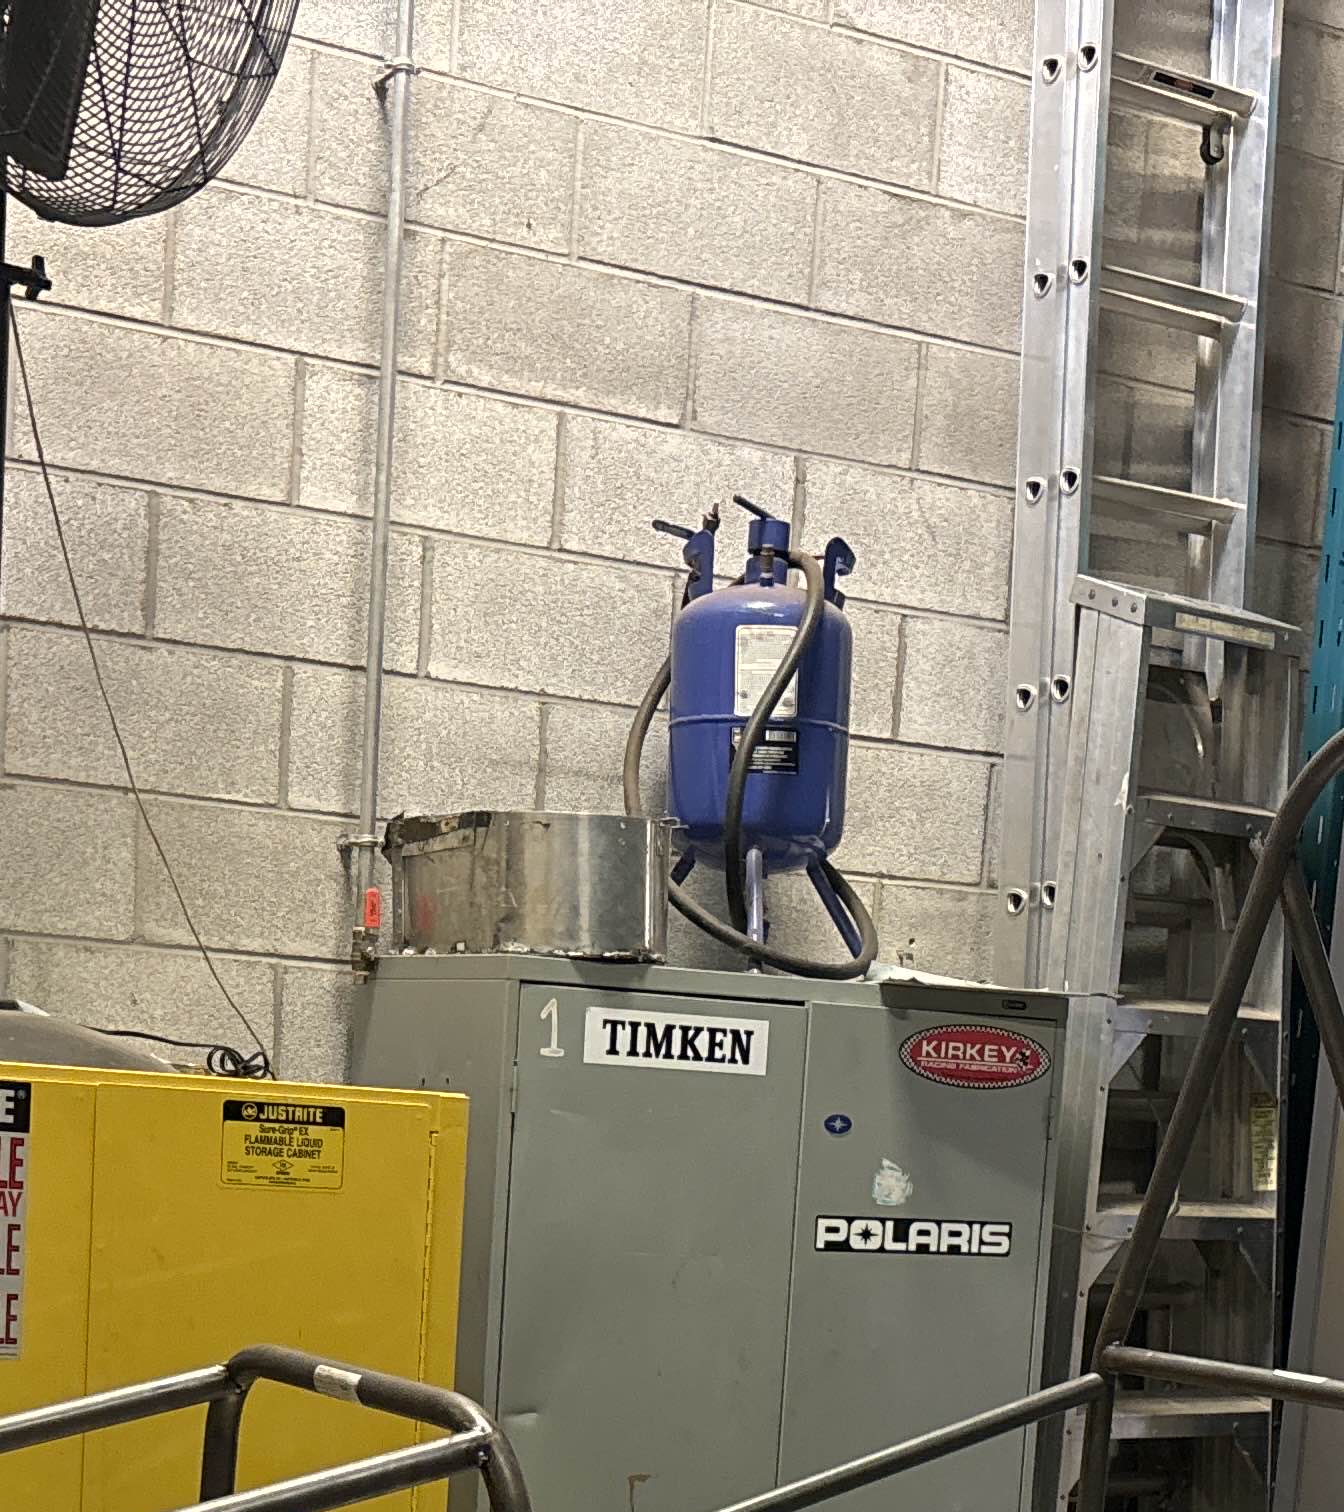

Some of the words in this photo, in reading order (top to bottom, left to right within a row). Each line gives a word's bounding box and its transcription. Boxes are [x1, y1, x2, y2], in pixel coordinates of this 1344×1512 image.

[539, 997, 565, 1058] 1
[602, 1019, 754, 1066] TIMKEN
[921, 1040, 1017, 1062] KIRKEY
[920, 1061, 958, 1070] RACING
[259, 1104, 324, 1123] JUSTRITE
[244, 1134, 294, 1147] FLAMMABLE
[297, 1137, 324, 1148] LIQUID
[244, 1145, 285, 1158] STORAGE
[286, 1147, 322, 1159] CABINET
[816, 1218, 1011, 1255] POLARIS
